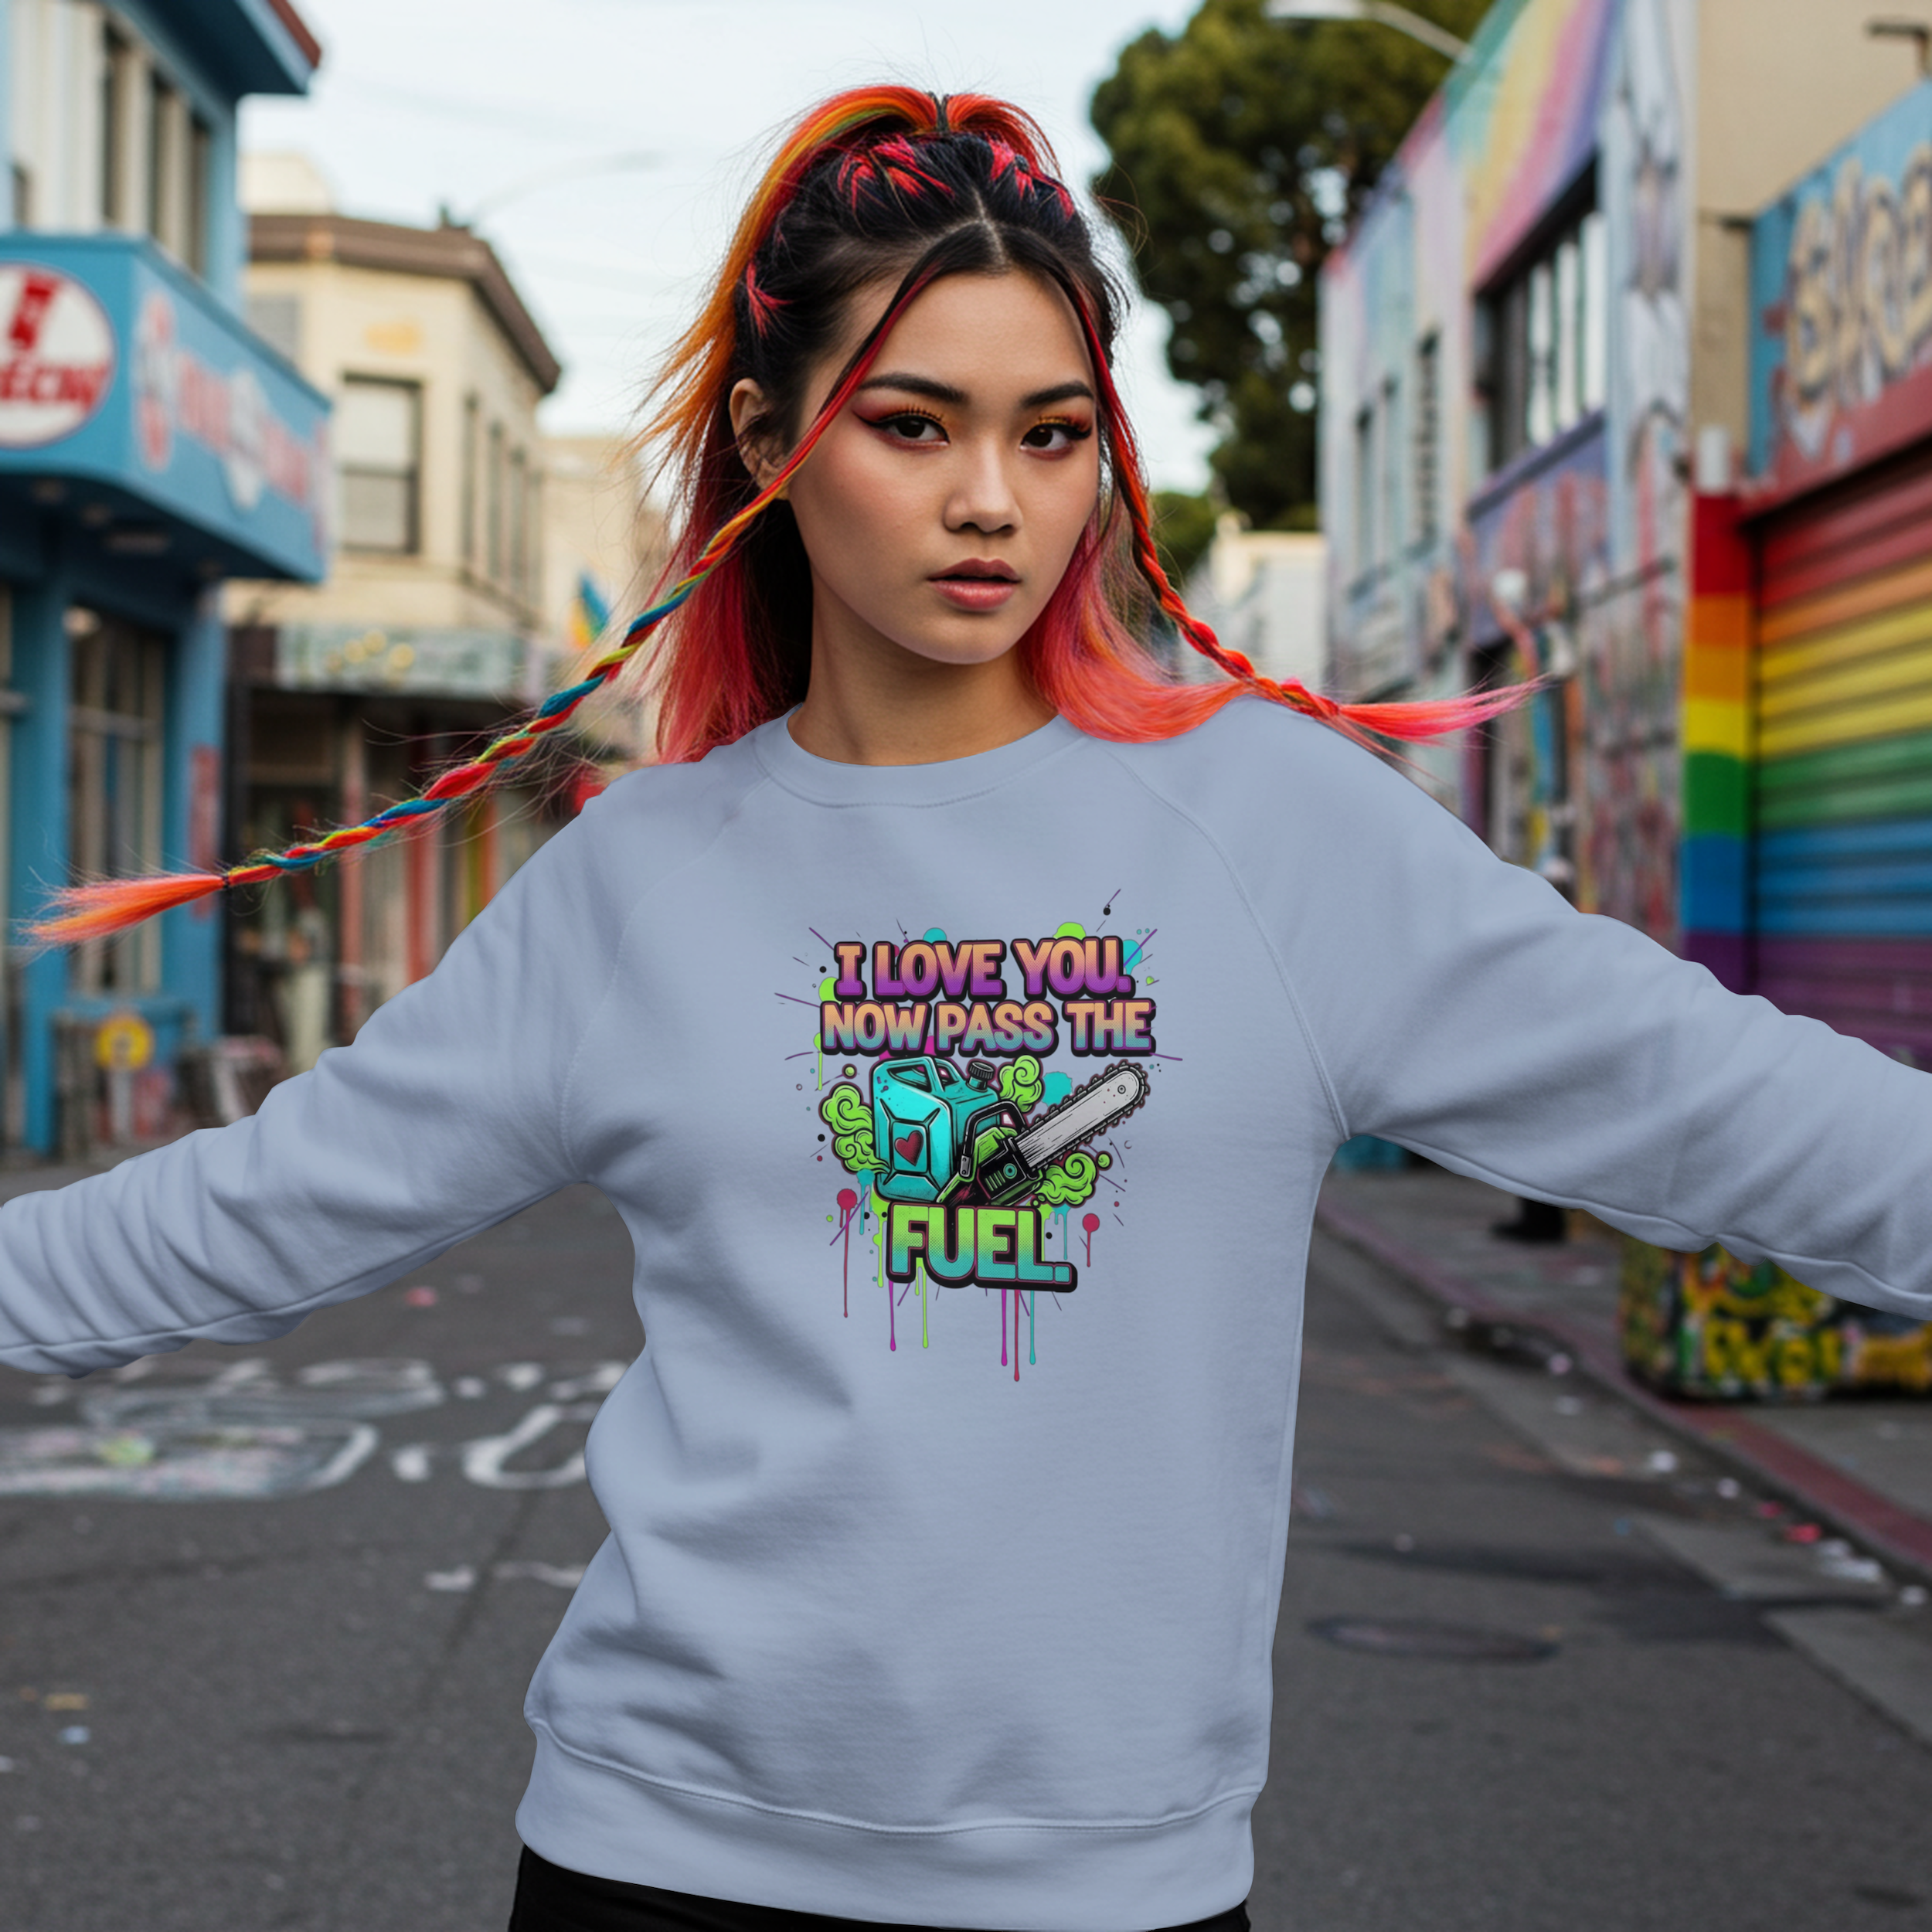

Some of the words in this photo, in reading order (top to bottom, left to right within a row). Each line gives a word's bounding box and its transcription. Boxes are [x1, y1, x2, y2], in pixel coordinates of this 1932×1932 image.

[834, 940, 867, 998] I
[872, 939, 1006, 1000] LOVE
[1012, 937, 1136, 1000] YOU.
[821, 1001, 930, 1055] NOW
[934, 1002, 1060, 1056] PASS
[1064, 998, 1156, 1056] THE
[886, 1202, 1078, 1293] FUEL.
